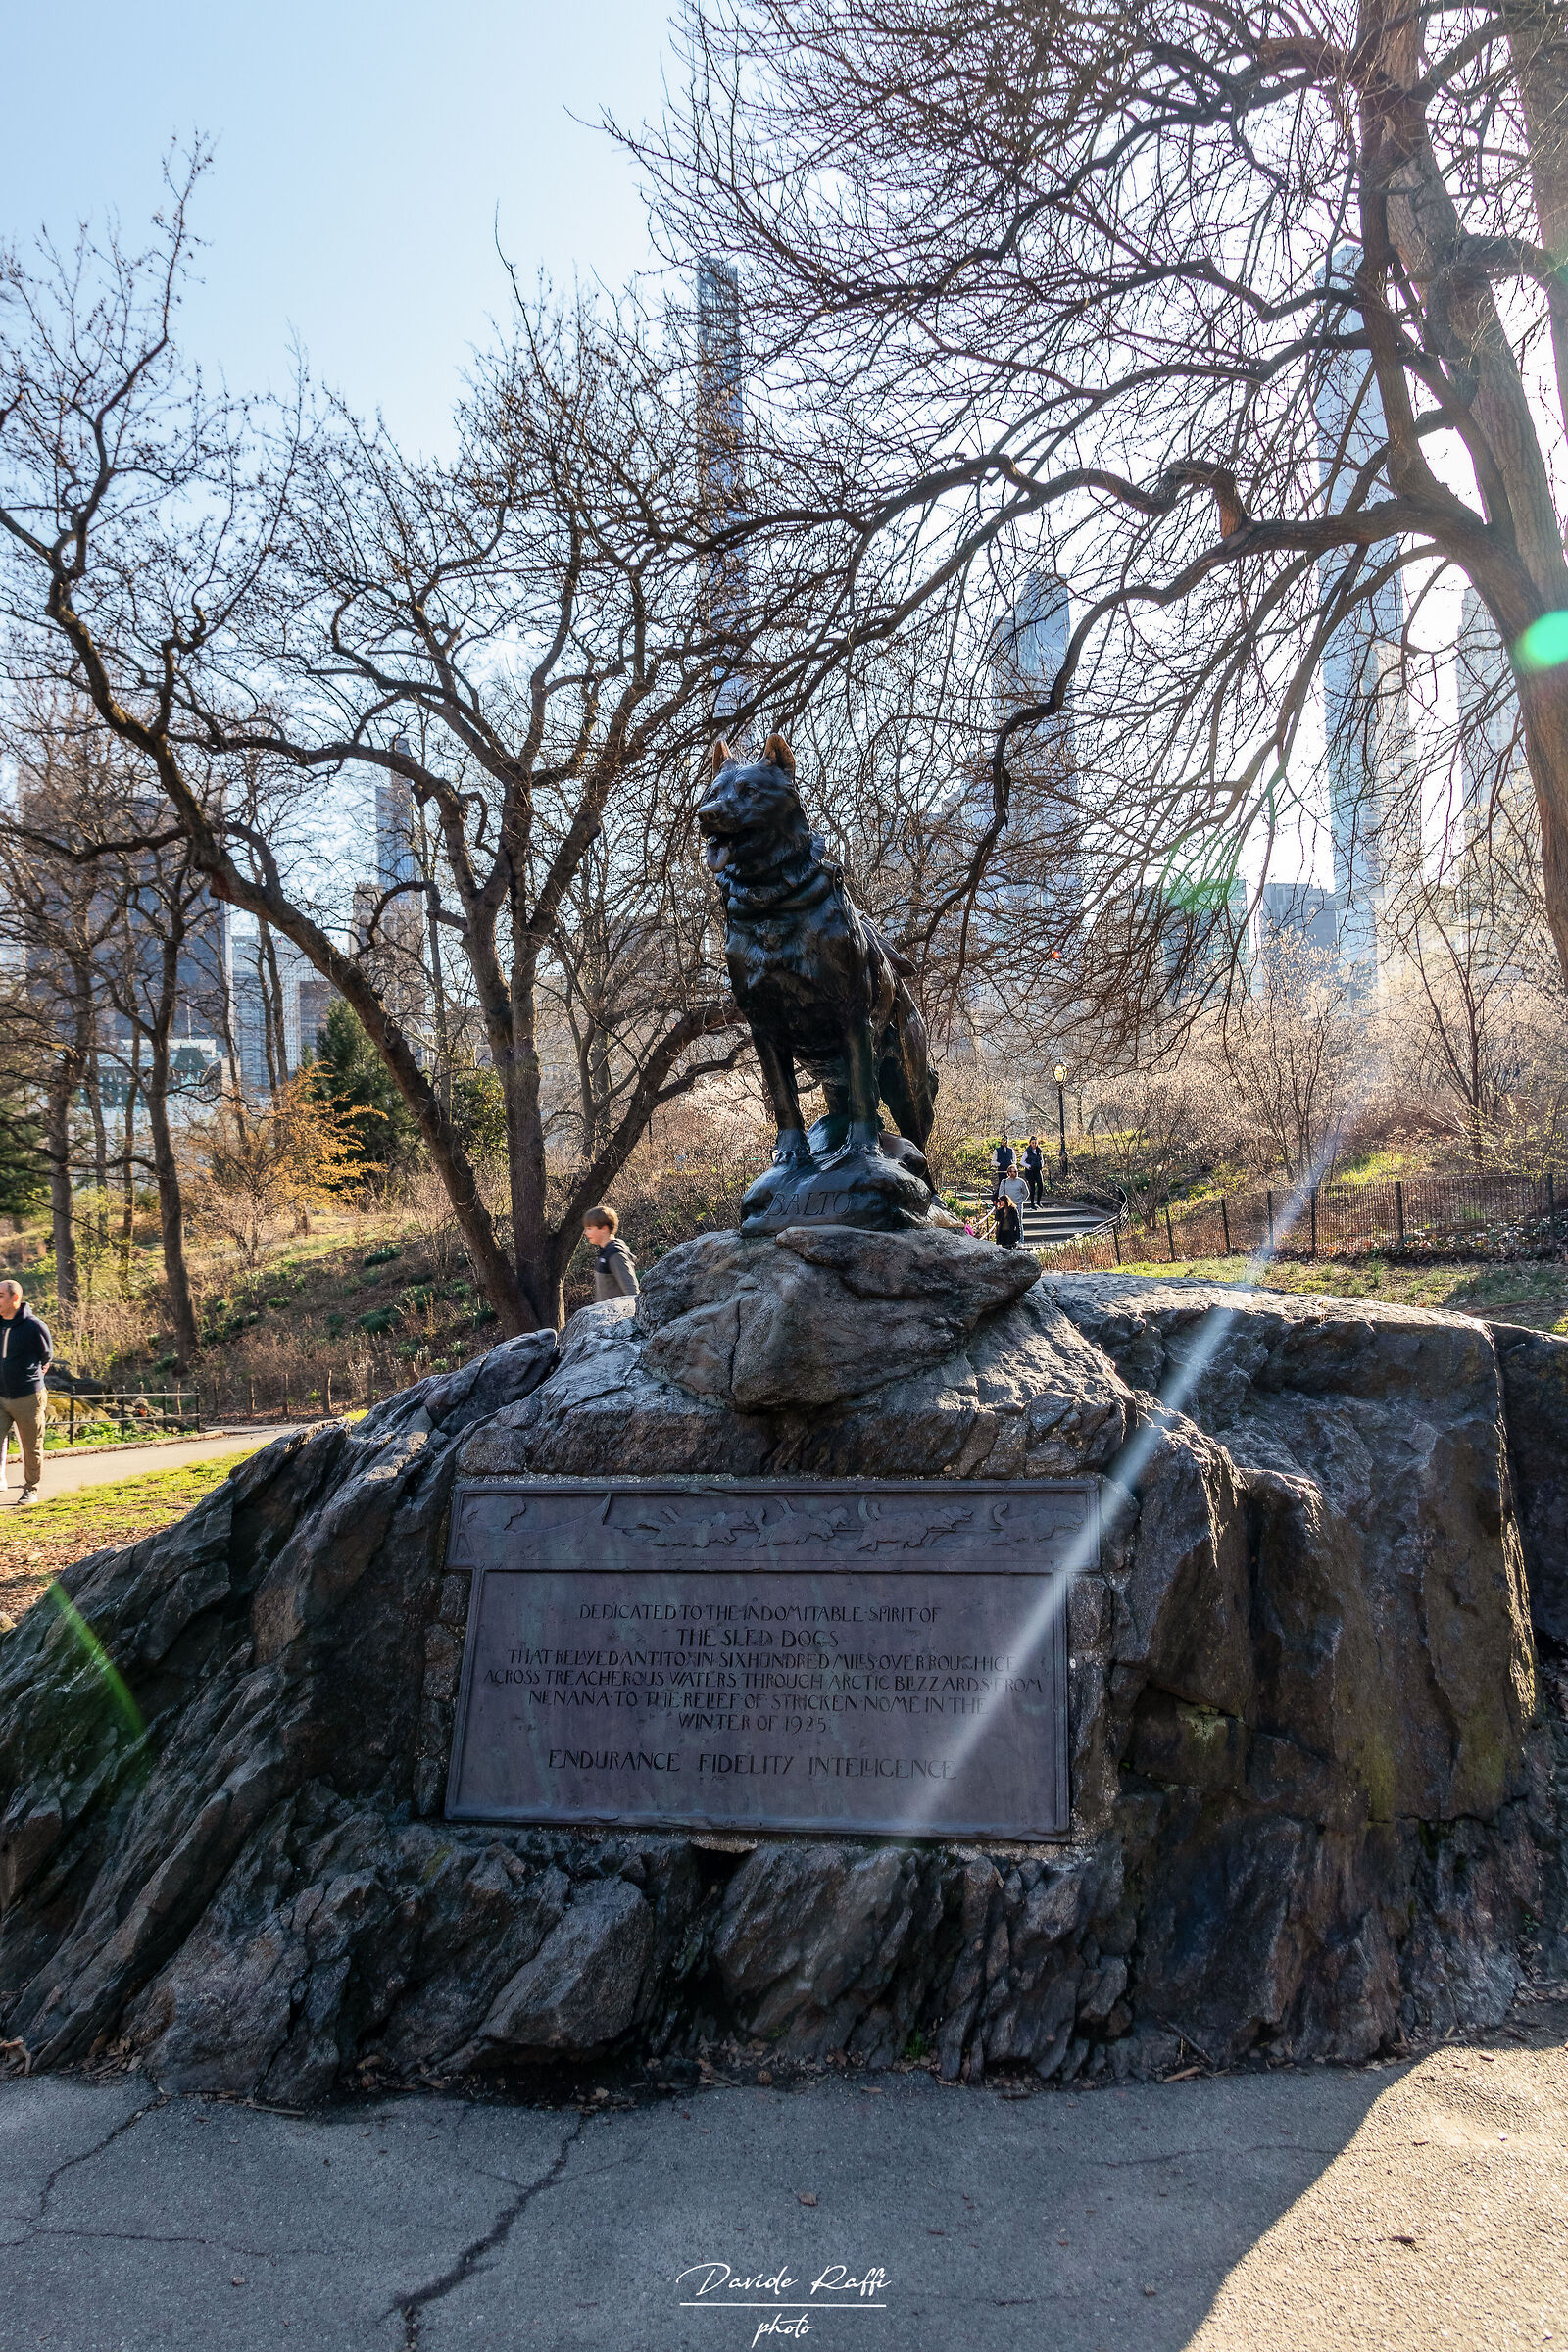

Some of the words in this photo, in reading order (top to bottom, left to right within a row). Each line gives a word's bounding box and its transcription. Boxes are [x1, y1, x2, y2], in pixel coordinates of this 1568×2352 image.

[765, 1190, 854, 1218] BALTO
[580, 1604, 677, 1620] DEDICATED
[680, 1605, 702, 1620] TO
[705, 1605, 738, 1620] THE
[743, 1605, 864, 1622] INDOMITABLE
[868, 1606, 916, 1623] SPIRIT
[919, 1607, 942, 1623] OF
[676, 1629, 716, 1647] THE
[720, 1629, 773, 1647] SLED
[781, 1630, 839, 1647] DOGS
[509, 1649, 553, 1665] THAT
[556, 1650, 619, 1666] RELAYED
[620, 1650, 713, 1667] ANTITOXIN
[719, 1651, 746, 1668] SIX
[748, 1652, 830, 1670] HUNDRED
[833, 1653, 875, 1670] MILES
[879, 1654, 924, 1672] OVER
[928, 1655, 986, 1672] ROUGH
[988, 1656, 1019, 1673] ICE
[484, 1669, 540, 1685] ACROSS
[545, 1670, 665, 1687] TREACHEROUS
[670, 1672, 736, 1688] WATERS
[741, 1673, 823, 1690] THROUGH
[829, 1674, 890, 1690] ARCTIC
[894, 1676, 990, 1692] BLIZZARDS
[992, 1678, 1043, 1694] FROM
[529, 1690, 610, 1706] NENANA
[613, 1691, 638, 1707] TO
[645, 1691, 680, 1708] THE
[683, 1692, 740, 1709] RELIEF
[744, 1693, 766, 1709] OF
[770, 1693, 858, 1712] STRICKEN
[864, 1695, 921, 1713] NOME
[924, 1696, 944, 1714] IN
[948, 1696, 989, 1715] THE
[678, 1713, 751, 1732] WINTER
[756, 1715, 776, 1732] OF
[548, 1749, 681, 1772] ENDURANCE
[698, 1753, 795, 1775] FIDELITY
[808, 1756, 957, 1780] INTELLIGENCE
